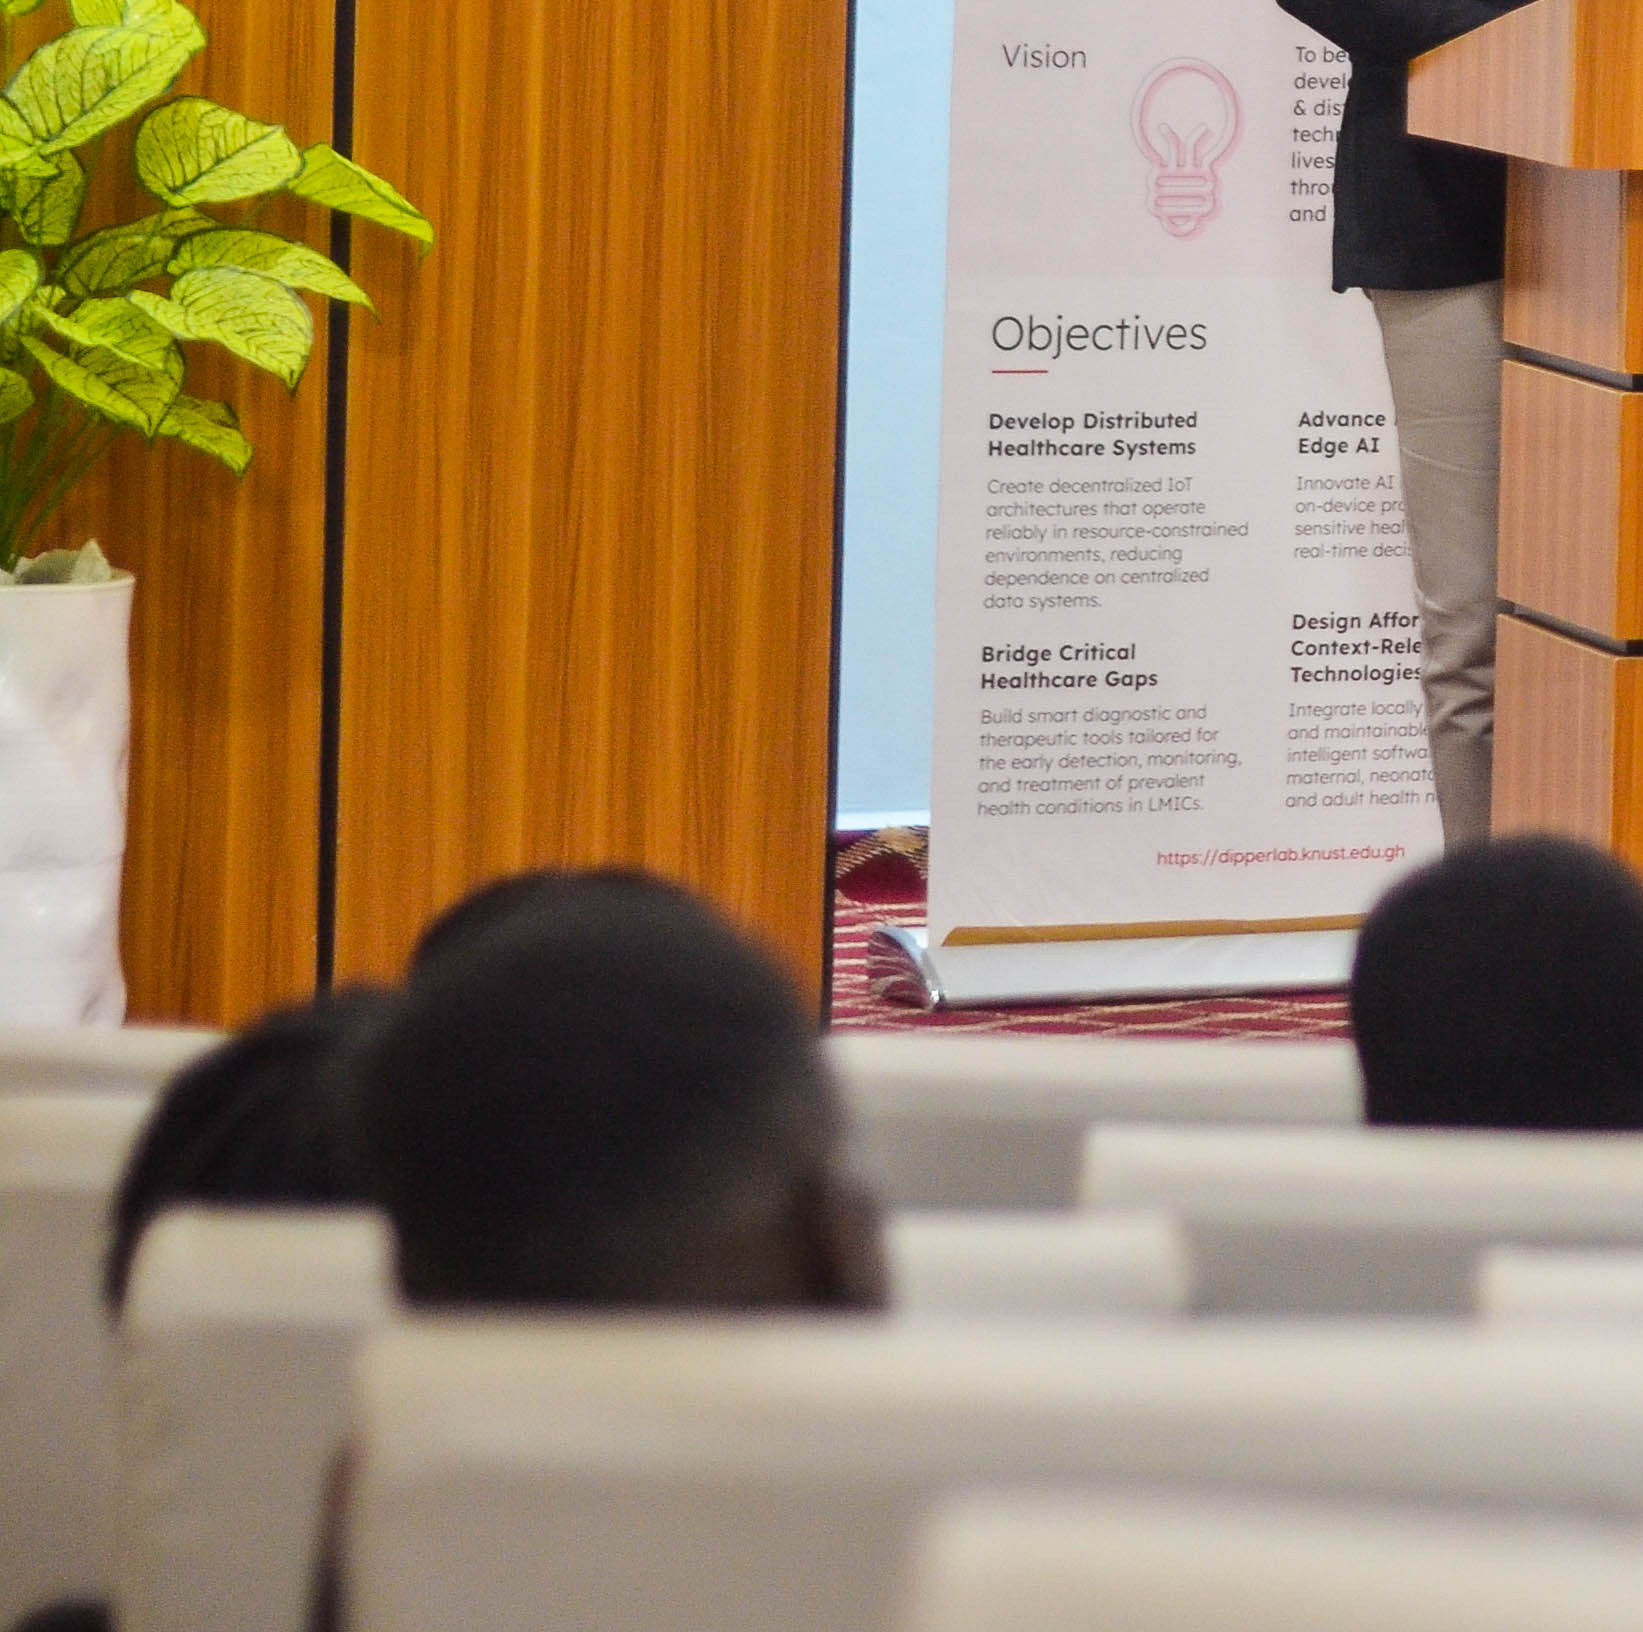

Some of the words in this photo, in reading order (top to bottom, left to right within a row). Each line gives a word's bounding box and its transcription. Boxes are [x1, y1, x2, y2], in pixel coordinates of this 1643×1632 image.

[1002, 44, 1087, 69] Vision
[1296, 46, 1316, 63] To
[1323, 46, 1351, 63] be
[1294, 73, 1350, 89] devel
[1294, 100, 1305, 116] &
[1314, 99, 1345, 116] dis
[1290, 206, 1326, 222] and
[992, 315, 1208, 359] Objectives
[990, 413, 1075, 433] Develop
[1083, 411, 1198, 429] Distributed
[1299, 411, 1386, 427] Advance
[989, 440, 1105, 456] Healthcare
[1112, 439, 1196, 460] Systems
[1299, 438, 1348, 458] Edge
[1356, 438, 1380, 453] AI
[987, 478, 1044, 494] Create
[1049, 477, 1162, 493] decentralized
[1168, 477, 1192, 493] IoT
[1297, 476, 1370, 490] Innovate
[1376, 475, 1394, 489] AI
[987, 500, 1098, 518] architectures
[1103, 500, 1137, 516] that
[1143, 500, 1205, 520] operate
[1296, 498, 1375, 512] on-device
[986, 522, 1047, 543] reliably
[1053, 523, 1067, 539] in
[1073, 521, 1248, 539] resource-constrained
[1295, 522, 1365, 535] sensitive
[1371, 521, 1406, 535] heal
[985, 546, 1105, 564] environments,
[1111, 545, 1183, 565] reducing
[1295, 544, 1368, 558] real-time
[984, 569, 1088, 587] dependence
[1094, 571, 1115, 584] on
[1121, 568, 1208, 584] centralized
[983, 593, 1023, 609] data
[1030, 593, 1101, 611] systems.
[1293, 612, 1360, 633] Design
[1369, 612, 1419, 629] Affor
[982, 645, 1052, 666] Bridge
[1059, 643, 1136, 661] Critical
[981, 671, 1098, 689] Healthcare
[1105, 671, 1158, 691] Gaps
[981, 709, 1022, 726] Build
[1028, 709, 1077, 724] smart
[1083, 706, 1171, 726] diagnostic
[1176, 705, 1207, 720] and
[1289, 703, 1367, 720] Integrate
[1371, 700, 1424, 718] locally
[980, 730, 1077, 750] therapeutic
[1083, 729, 1122, 745] tools
[1129, 727, 1191, 743] tailored
[1197, 726, 1219, 742] for
[1288, 726, 1319, 740] and
[980, 754, 1006, 770] the
[1012, 753, 1054, 773] early
[1058, 751, 1143, 770] detection,
[1148, 749, 1242, 770] monitoring,
[1288, 749, 1367, 765] intelligent
[978, 777, 1010, 793] and
[1017, 775, 1100, 792] treatment
[1105, 774, 1123, 790] of
[1128, 773, 1205, 792] prevalent
[1287, 772, 1364, 785] maternal,
[978, 799, 1030, 816] health
[1036, 798, 1122, 814] conditions
[1129, 798, 1142, 813] in
[1149, 795, 1204, 813] LMICs.
[1286, 794, 1317, 807] and
[1322, 793, 1364, 806] adult
[1370, 791, 1420, 805] health
[1157, 844, 1405, 867] https://dipperlab.knust.edu.gh
